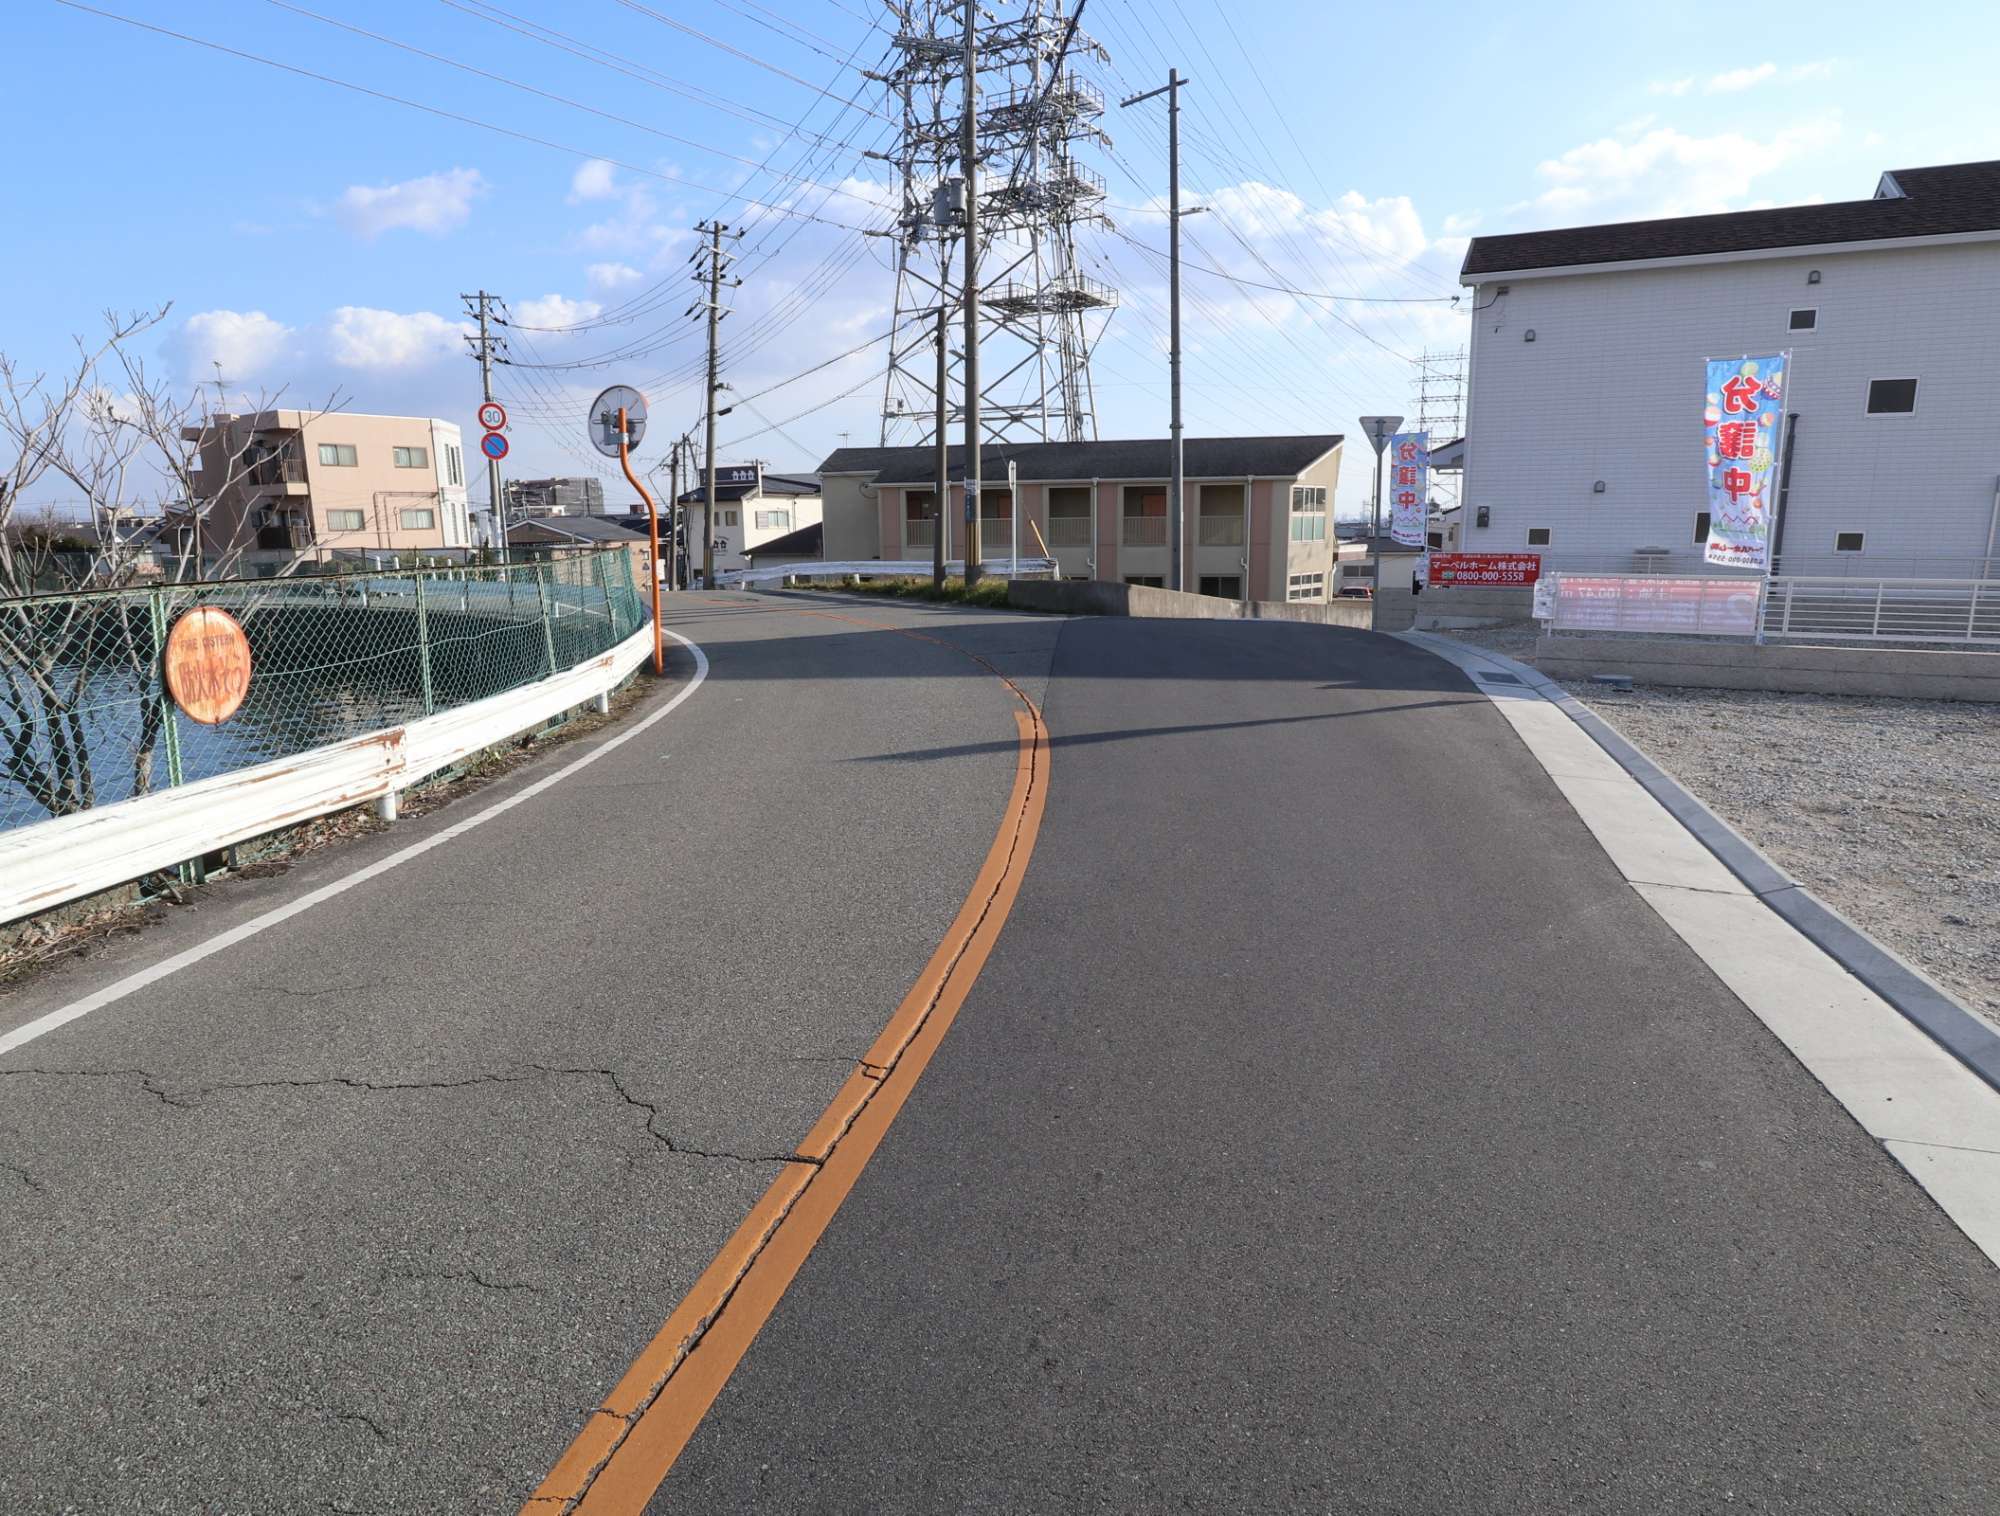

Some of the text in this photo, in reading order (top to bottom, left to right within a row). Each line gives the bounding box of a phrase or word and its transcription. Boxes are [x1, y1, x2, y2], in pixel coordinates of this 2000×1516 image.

[485, 410, 500, 423] 30
[1432, 561, 1537, 571] マーベルホーム株式会社
[1456, 571, 1525, 581] 0800-000-5558
